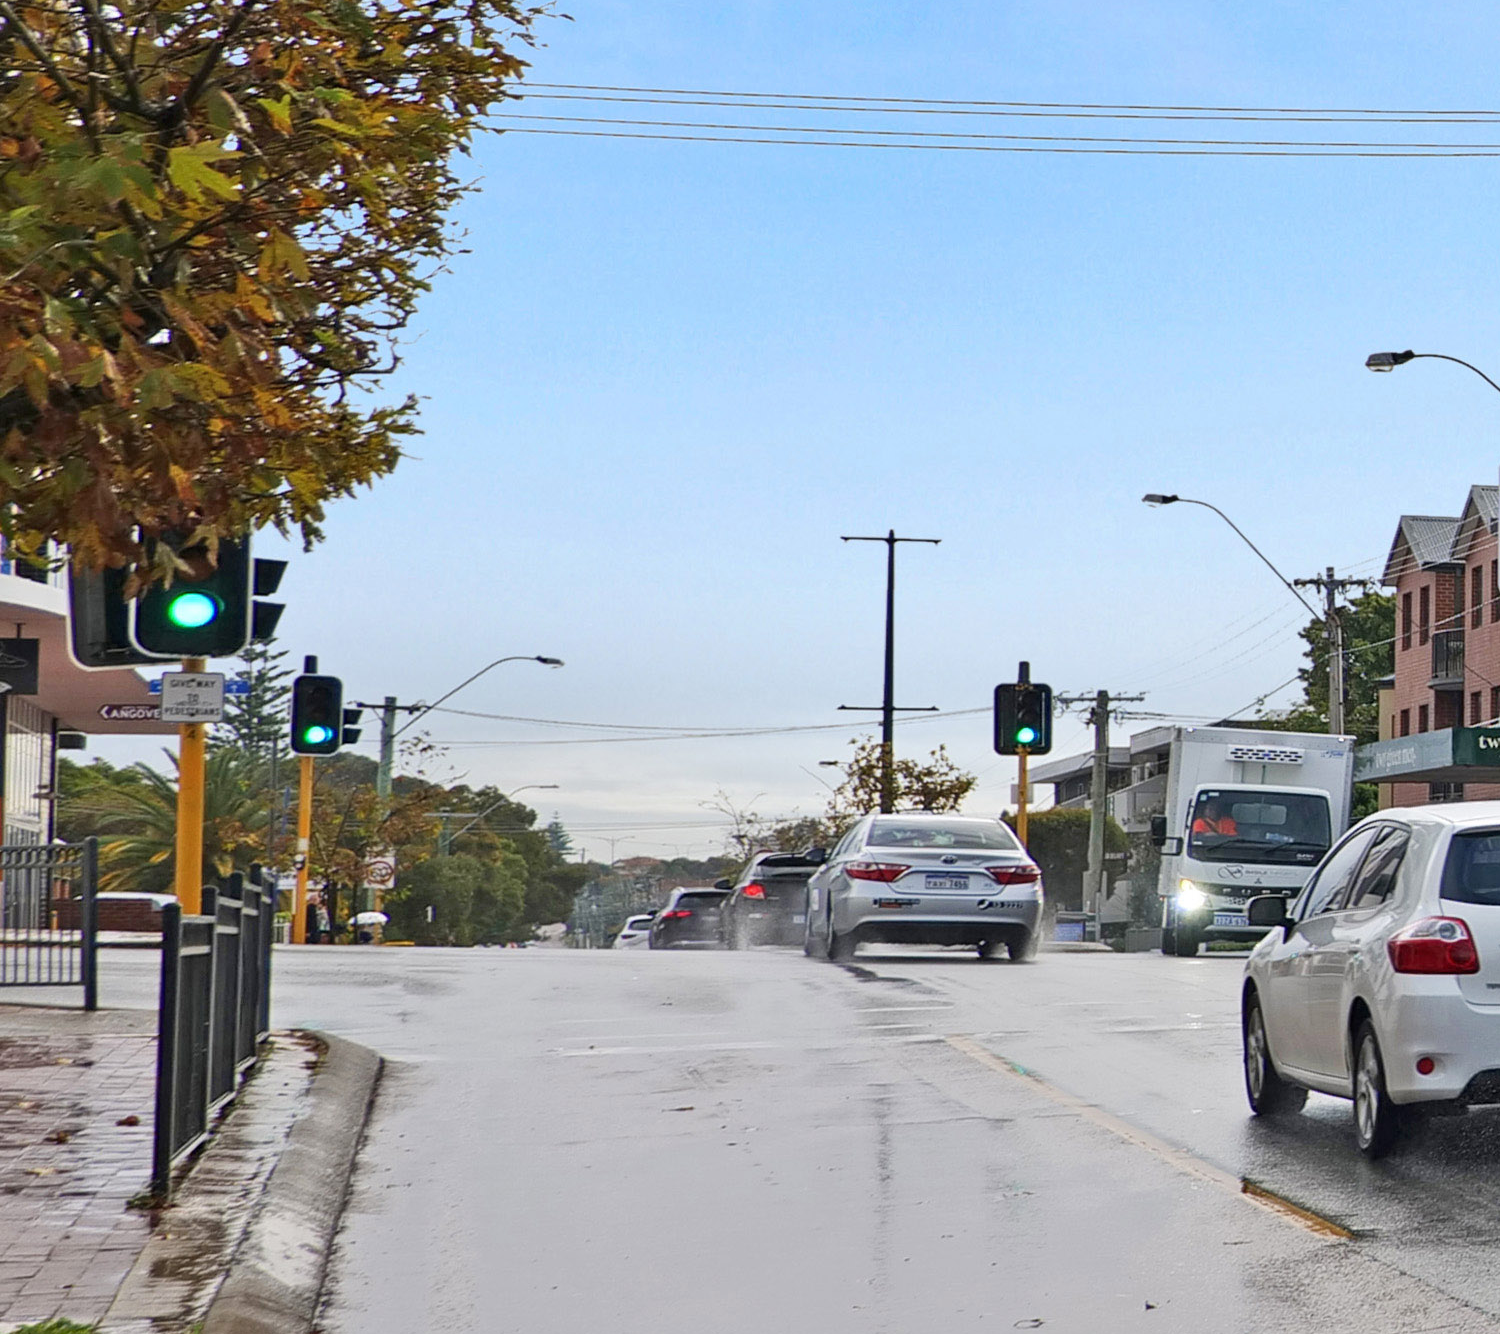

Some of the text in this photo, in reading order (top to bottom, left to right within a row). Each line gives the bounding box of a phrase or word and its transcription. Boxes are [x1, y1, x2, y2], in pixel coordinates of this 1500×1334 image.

[170, 679, 218, 688] GIVE WAY
[110, 707, 161, 718] ANGOVE
